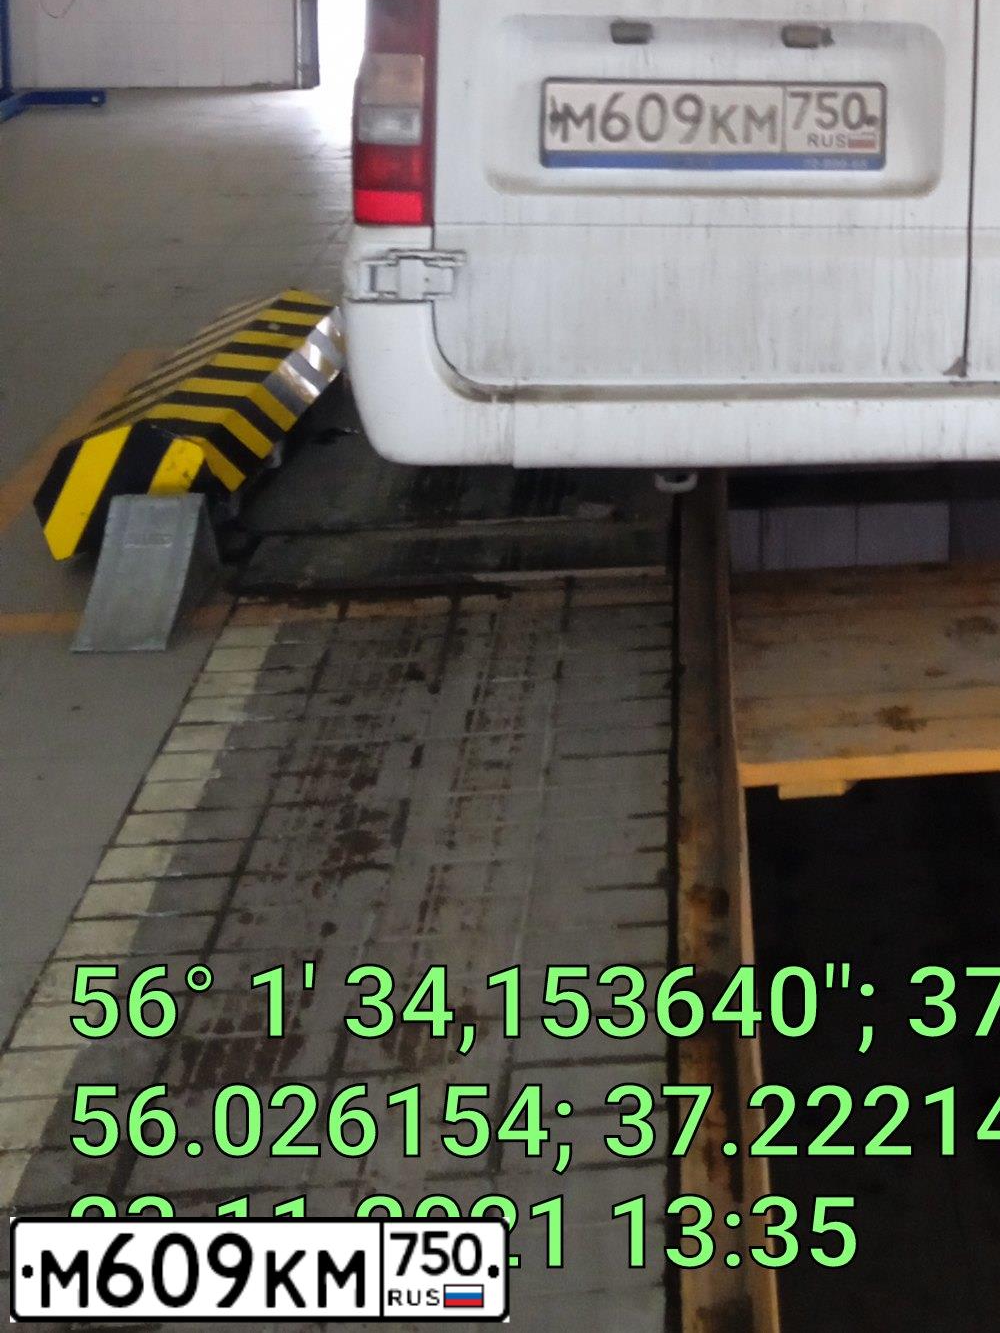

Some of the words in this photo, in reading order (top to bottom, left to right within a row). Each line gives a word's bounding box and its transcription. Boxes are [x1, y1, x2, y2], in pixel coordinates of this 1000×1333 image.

[560, 91, 778, 145] М609КМ
[789, 91, 868, 131] 750
[806, 132, 847, 148] RUS
